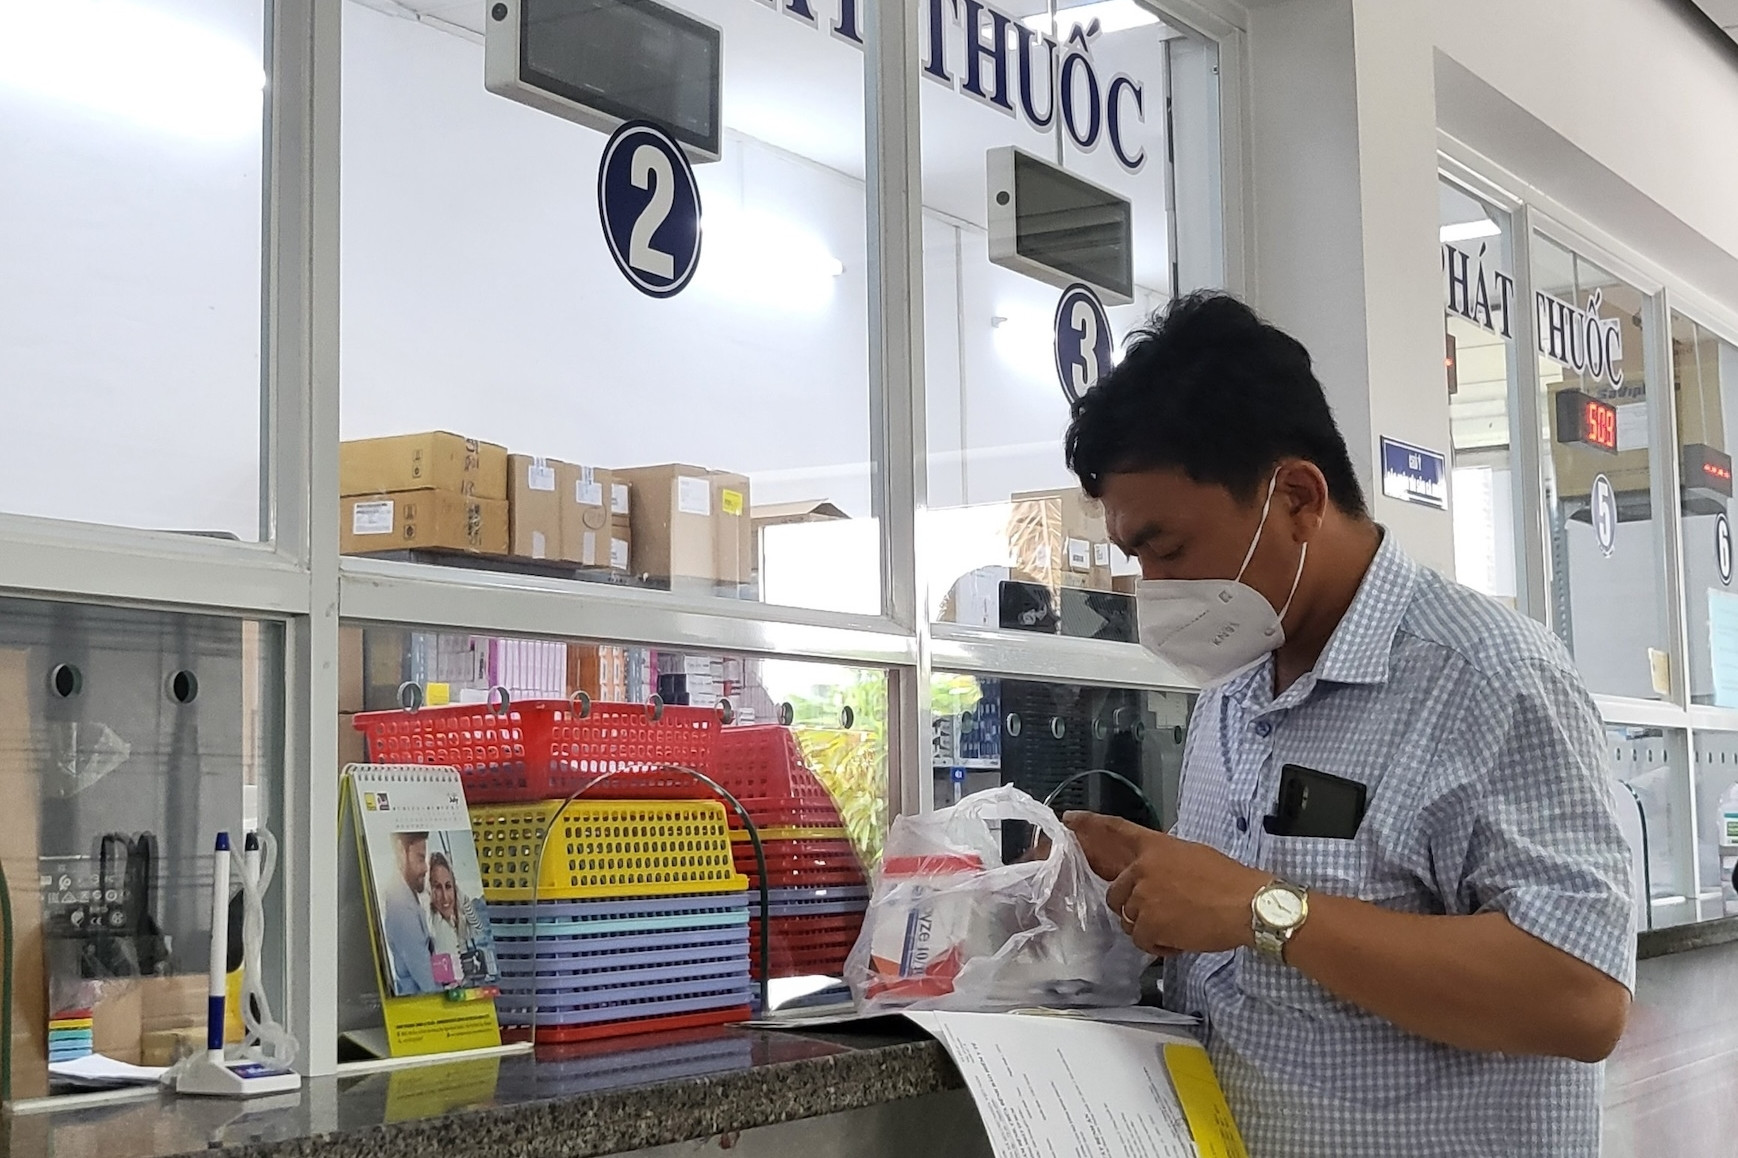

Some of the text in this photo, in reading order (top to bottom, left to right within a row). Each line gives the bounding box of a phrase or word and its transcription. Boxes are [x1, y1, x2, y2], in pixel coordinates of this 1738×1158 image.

[922, 0, 1146, 170] THUỐC
[628, 144, 675, 280] 2
[1070, 300, 1099, 398] 3
[1441, 242, 1622, 386] HÁT THUỐC
[1597, 480, 1612, 547] 5
[1717, 518, 1730, 579] 6
